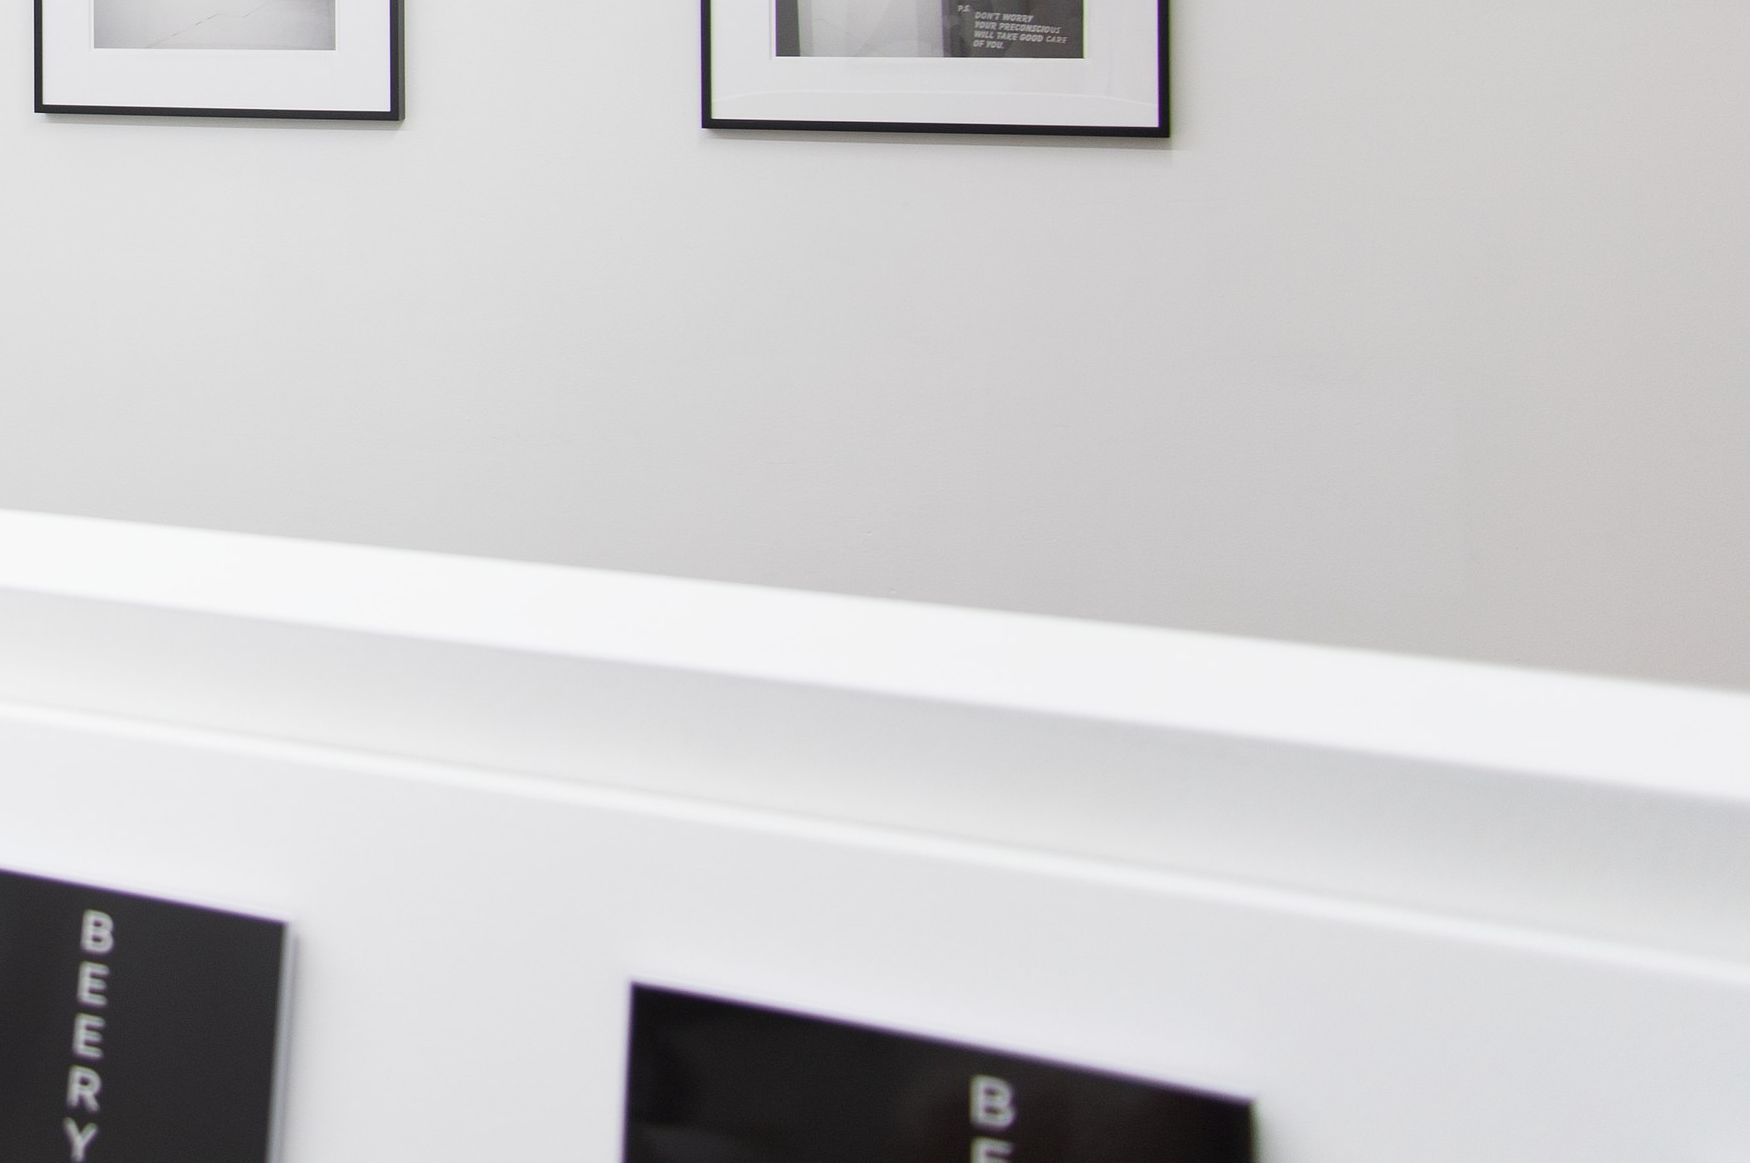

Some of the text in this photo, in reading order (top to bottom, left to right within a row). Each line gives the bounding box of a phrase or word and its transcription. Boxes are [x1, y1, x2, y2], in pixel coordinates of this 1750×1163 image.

[974, 11, 1034, 23] DON'T WORRY
[974, 21, 1062, 34] YOUR PRECONSCIOUS
[973, 30, 1068, 44] WILL TAKE GOOD CARE
[973, 39, 1004, 49] OF YOU.
[62, 908, 115, 1163] BEERY
